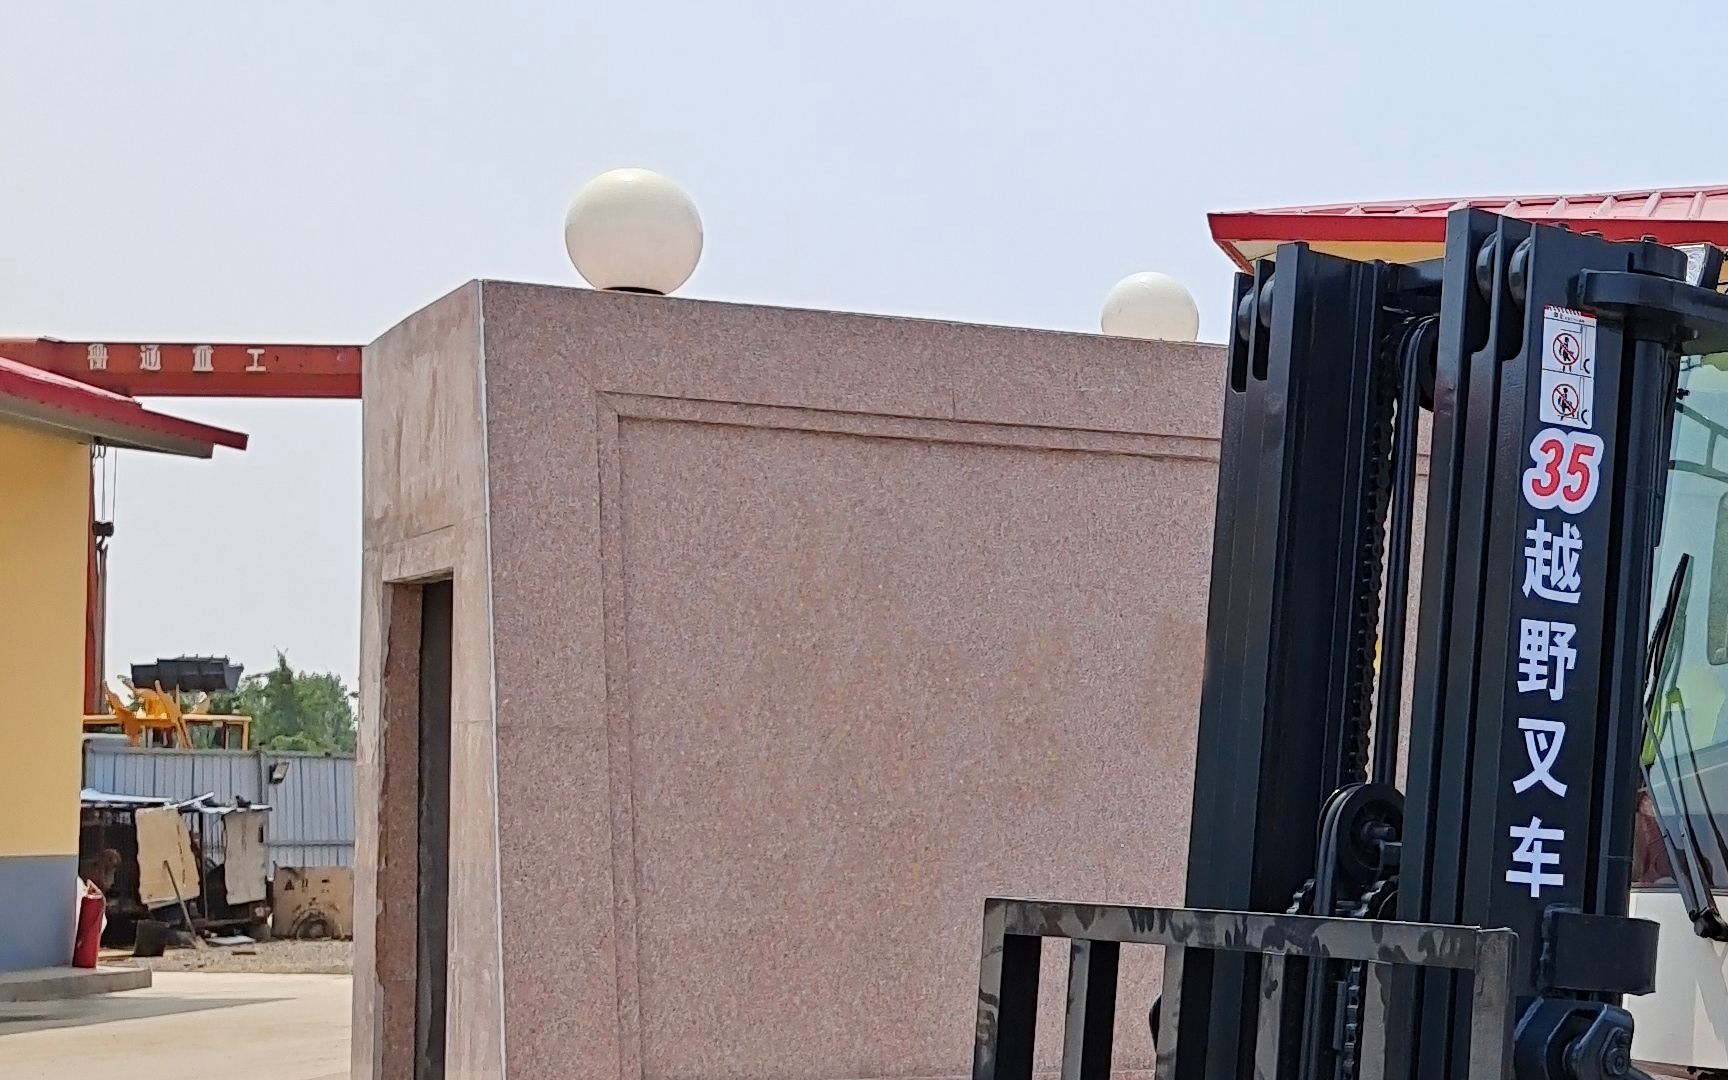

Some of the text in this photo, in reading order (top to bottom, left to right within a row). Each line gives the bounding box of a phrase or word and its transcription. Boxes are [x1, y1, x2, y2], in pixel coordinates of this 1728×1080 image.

[1530, 437, 1597, 504] 35
[1505, 518, 1584, 898] 越野叉车
